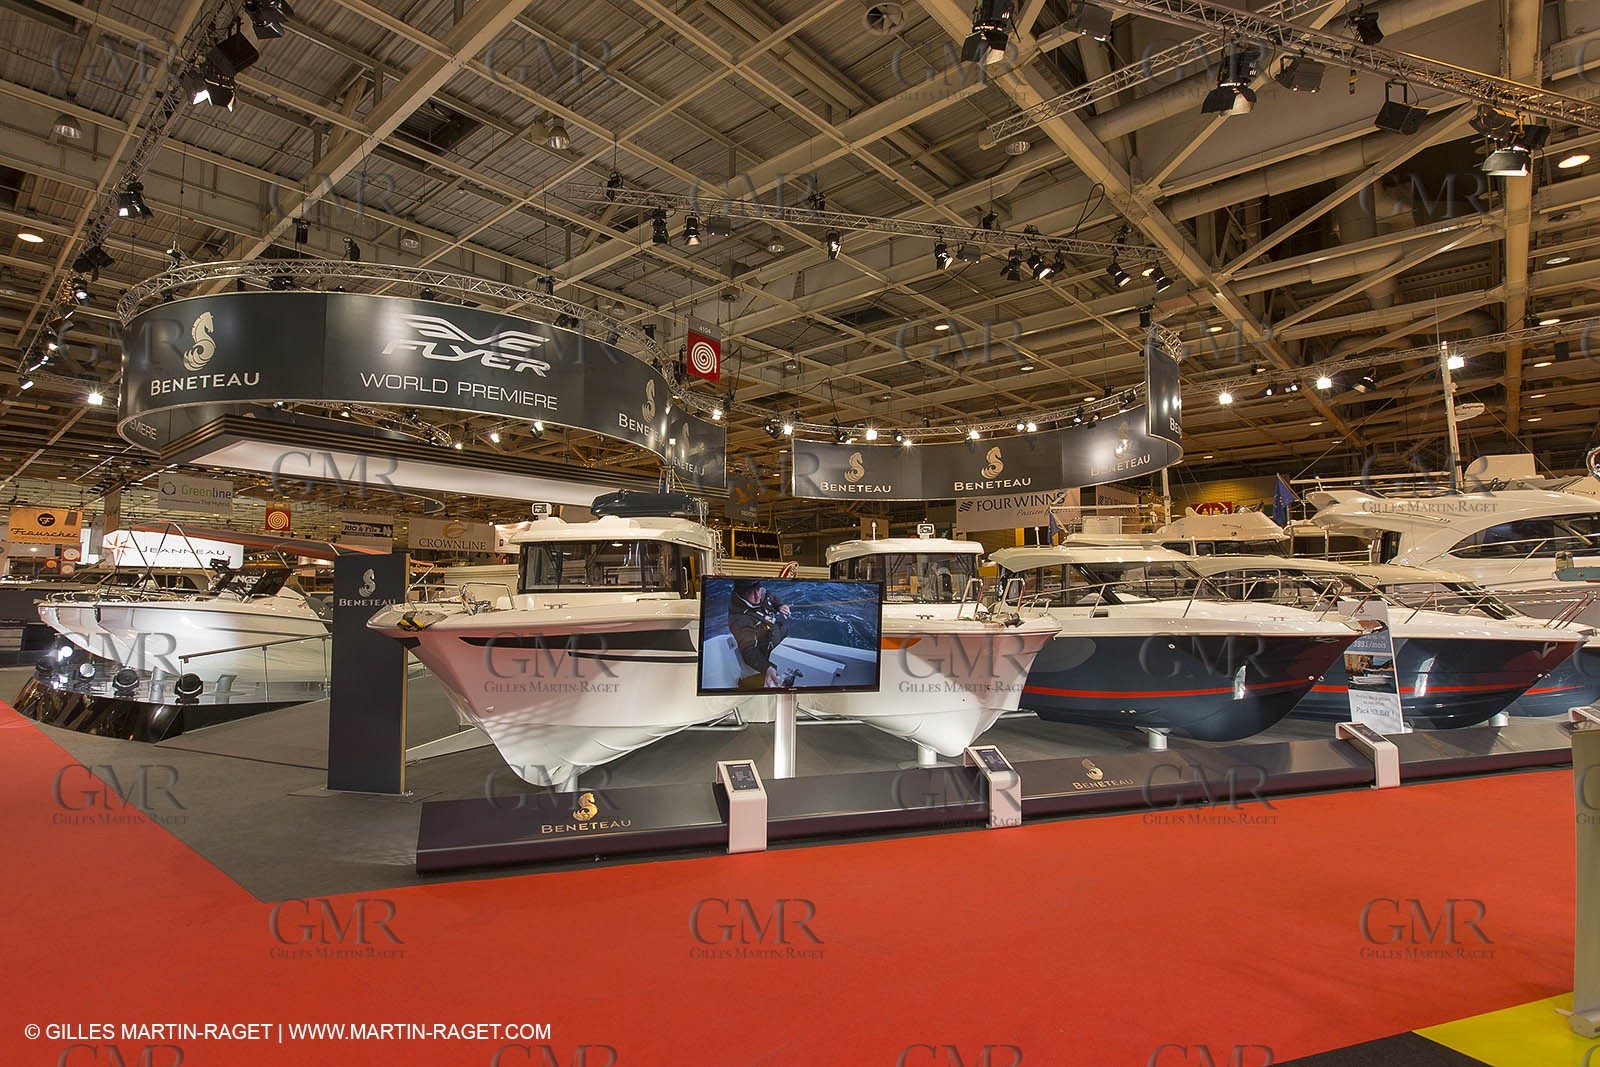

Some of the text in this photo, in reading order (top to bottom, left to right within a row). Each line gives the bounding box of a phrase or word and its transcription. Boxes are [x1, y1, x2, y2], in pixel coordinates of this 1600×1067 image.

[382, 338, 551, 378] FLYER
[150, 371, 261, 396] BENETEAU
[360, 371, 558, 411] WORLD PREMIERE
[181, 484, 232, 499] Greenline
[821, 481, 892, 494] BENETEAU
[954, 477, 1032, 492] BENETEAU
[976, 491, 1066, 512] FOUR WINNS
[142, 545, 226, 555] JEANNEAU
[418, 537, 486, 551] CROWNLINE
[338, 599, 398, 607] BENETEAU
[1071, 778, 1136, 790] BENETEAU
[541, 818, 632, 834] BENETEAU
